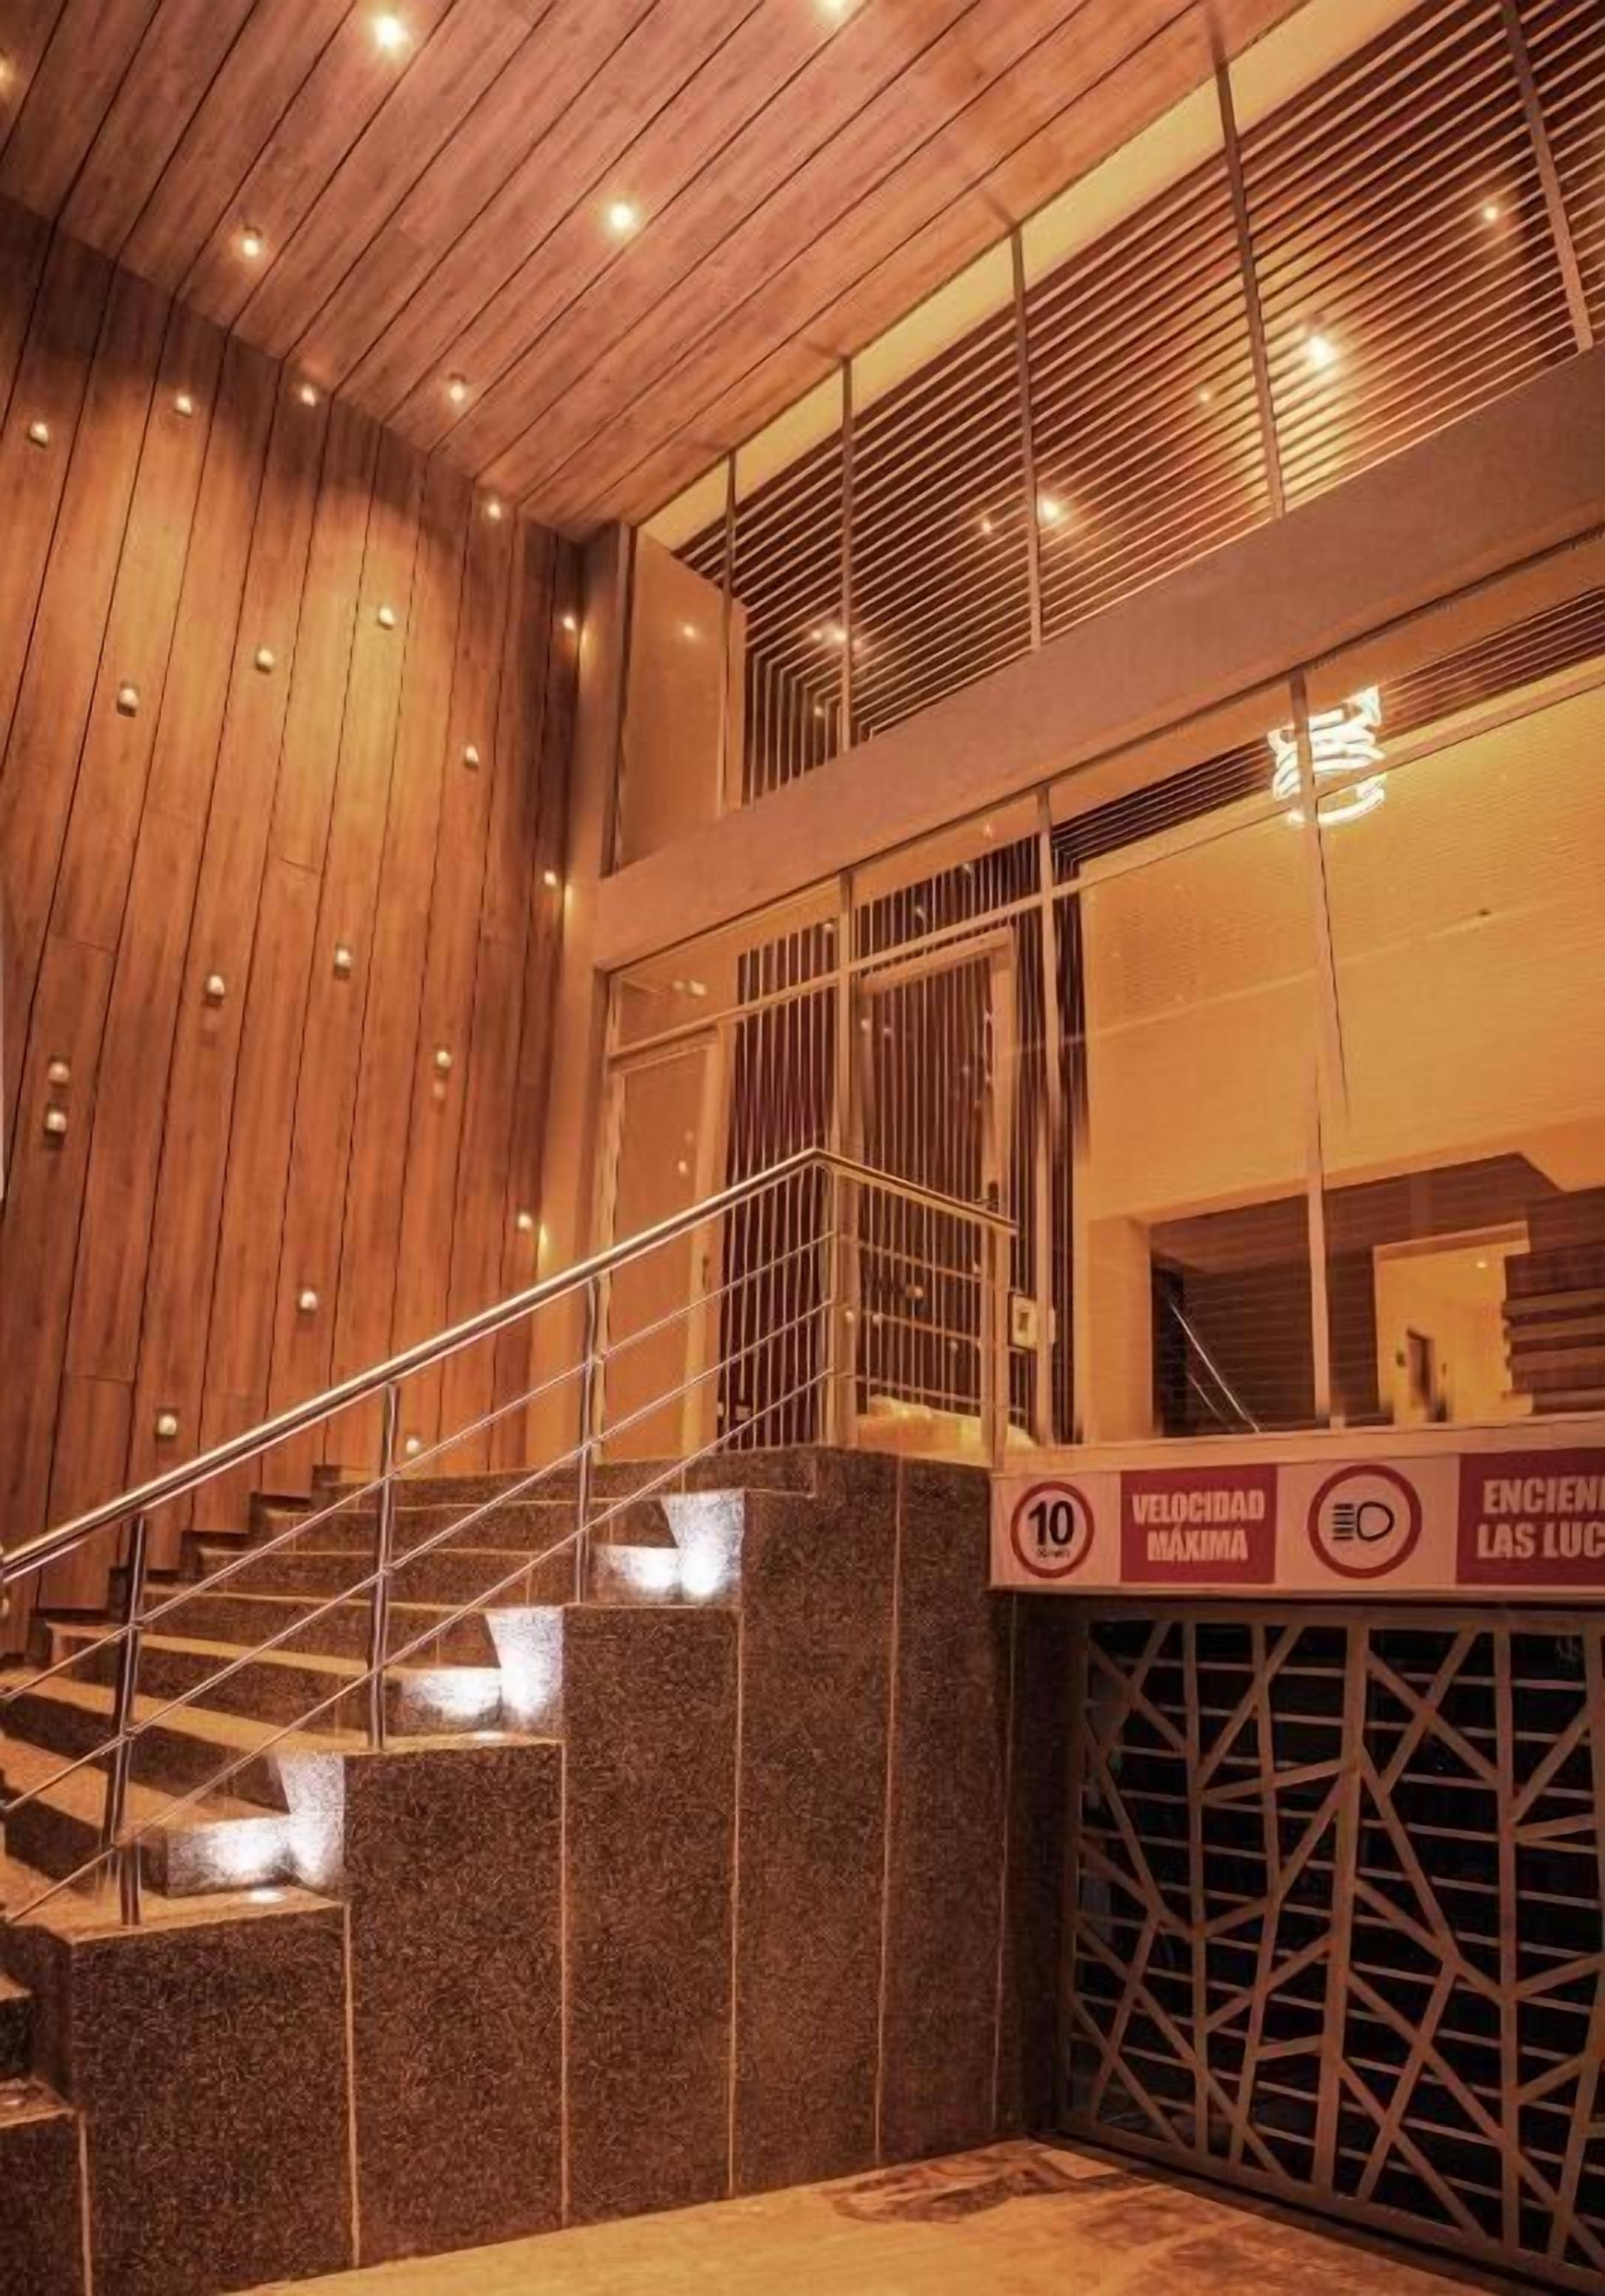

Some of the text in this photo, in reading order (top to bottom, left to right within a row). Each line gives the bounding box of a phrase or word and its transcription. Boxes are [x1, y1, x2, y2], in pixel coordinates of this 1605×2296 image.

[1027, 1499, 1074, 1546] 10
[1131, 1489, 1265, 1525] VELOCIDAD
[1146, 1523, 1249, 1562] MÁXIMA
[1477, 1520, 1605, 1558] LAS LUC
